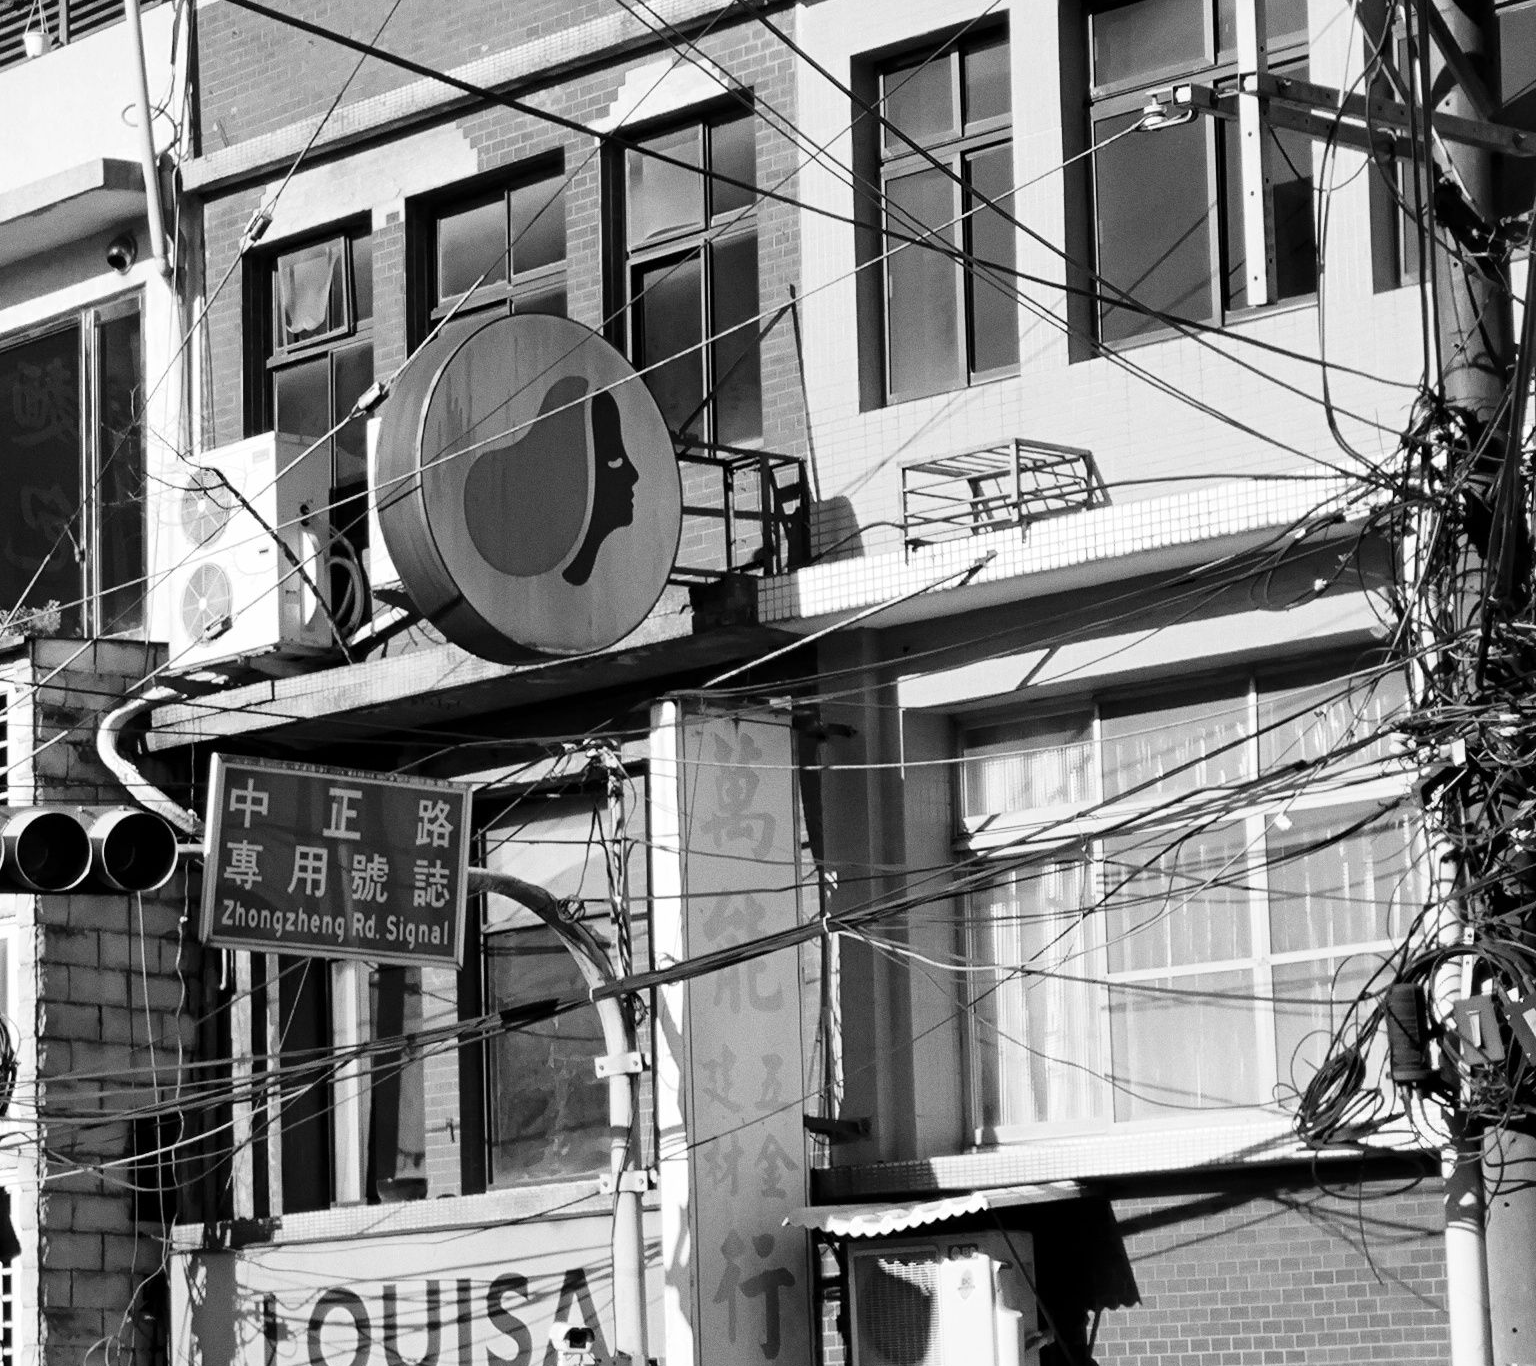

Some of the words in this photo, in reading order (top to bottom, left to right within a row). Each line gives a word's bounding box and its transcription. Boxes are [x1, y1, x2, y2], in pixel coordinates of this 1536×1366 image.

[228, 777, 454, 849] 中正路
[223, 839, 451, 908] 專用號誌
[221, 899, 346, 942] Zhongzheng
[351, 912, 381, 941] Rd.
[385, 914, 450, 950] Signal
